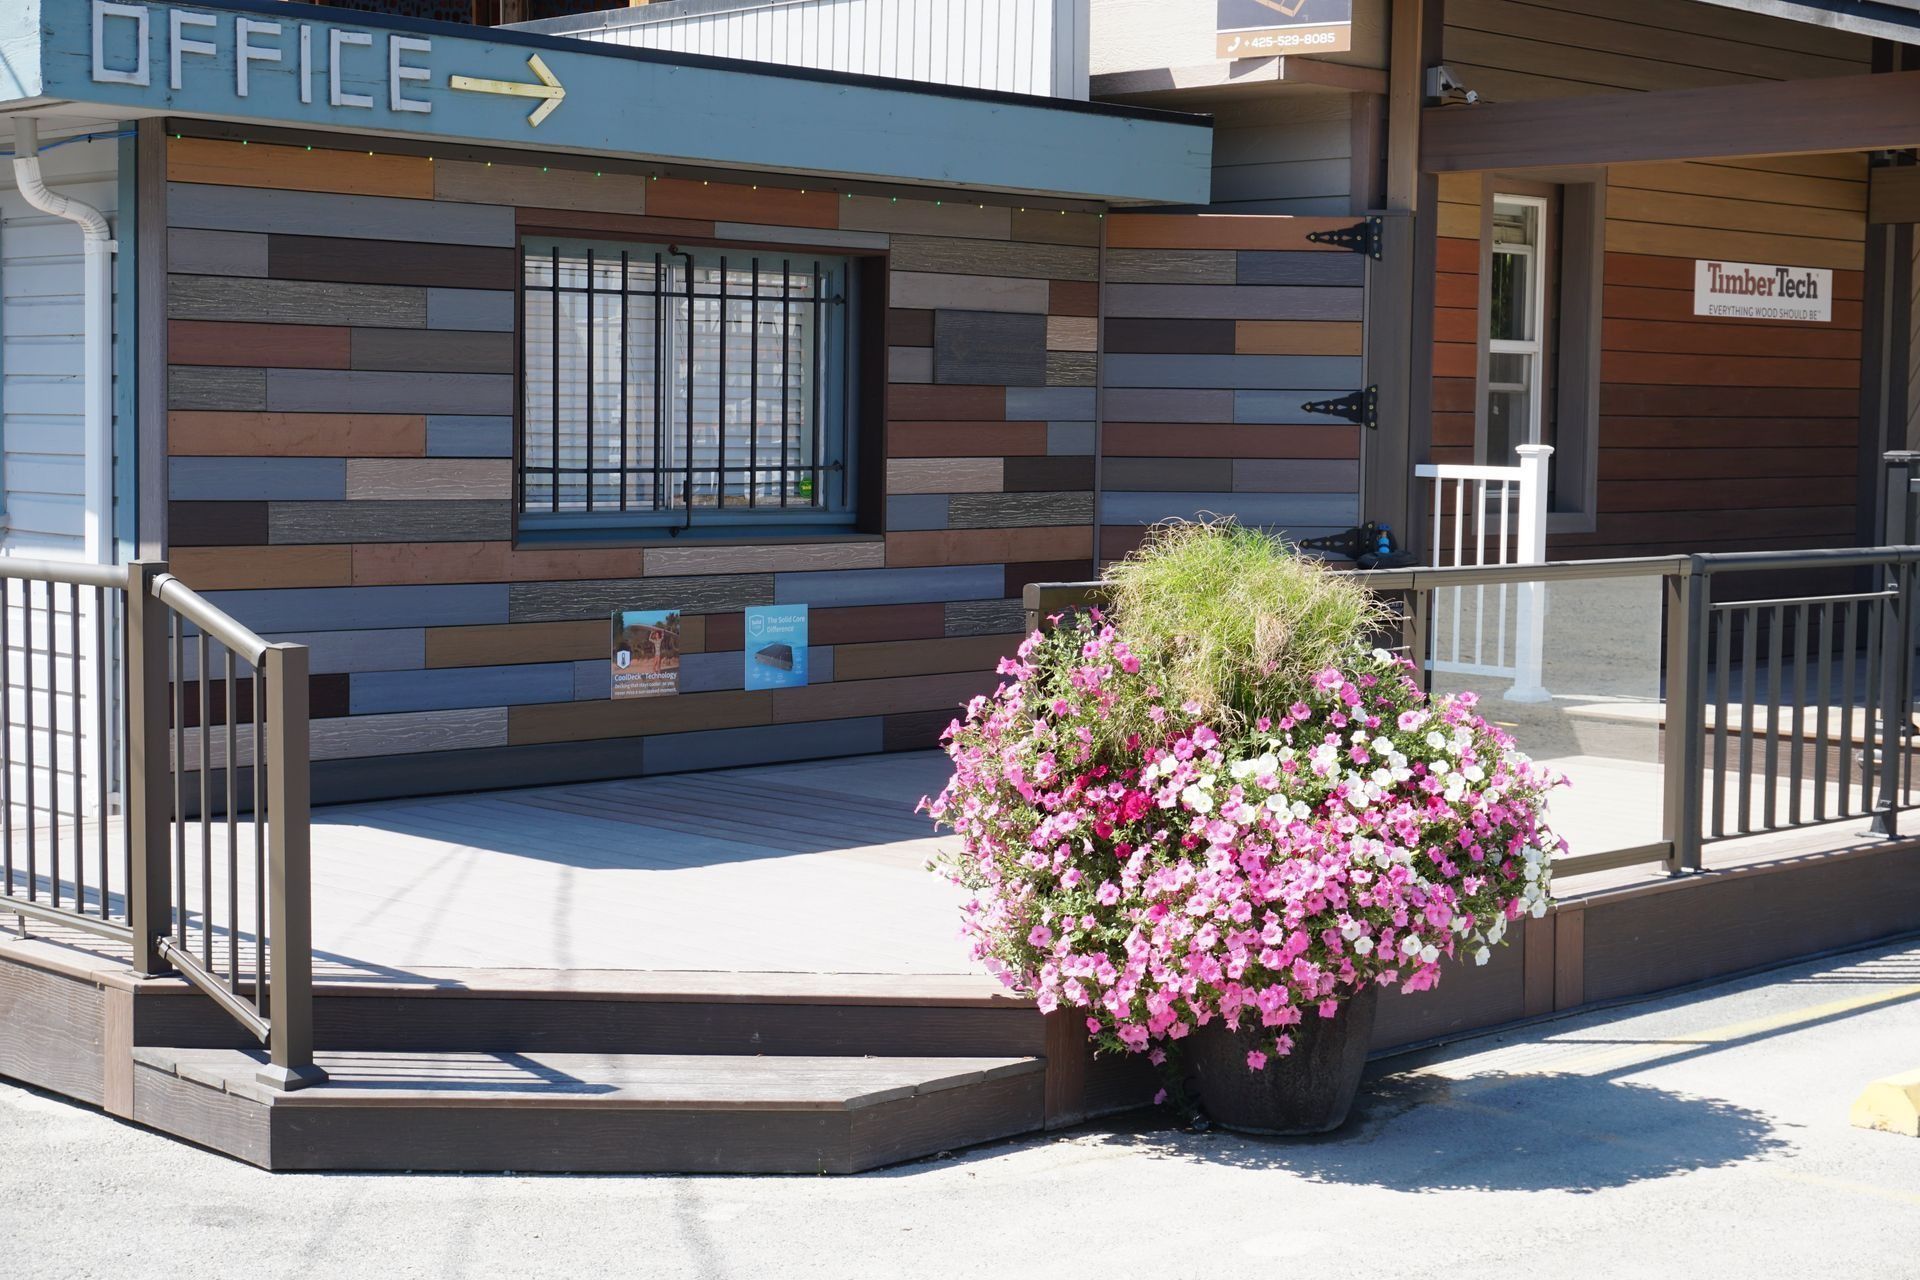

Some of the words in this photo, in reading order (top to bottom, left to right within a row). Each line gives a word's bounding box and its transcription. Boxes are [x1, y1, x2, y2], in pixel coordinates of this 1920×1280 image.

[91, 4, 432, 113] OFFICE
[1707, 262, 1818, 299] TimberTech
[1709, 304, 1753, 317] EVERYTHING
[1755, 306, 1778, 318] WOOD
[1779, 308, 1807, 320] SHOULD
[767, 616, 777, 624] The
[778, 615, 792, 623] Solid
[793, 615, 805, 623] Core
[766, 625, 794, 633] Difference
[645, 672, 677, 680] Technology
